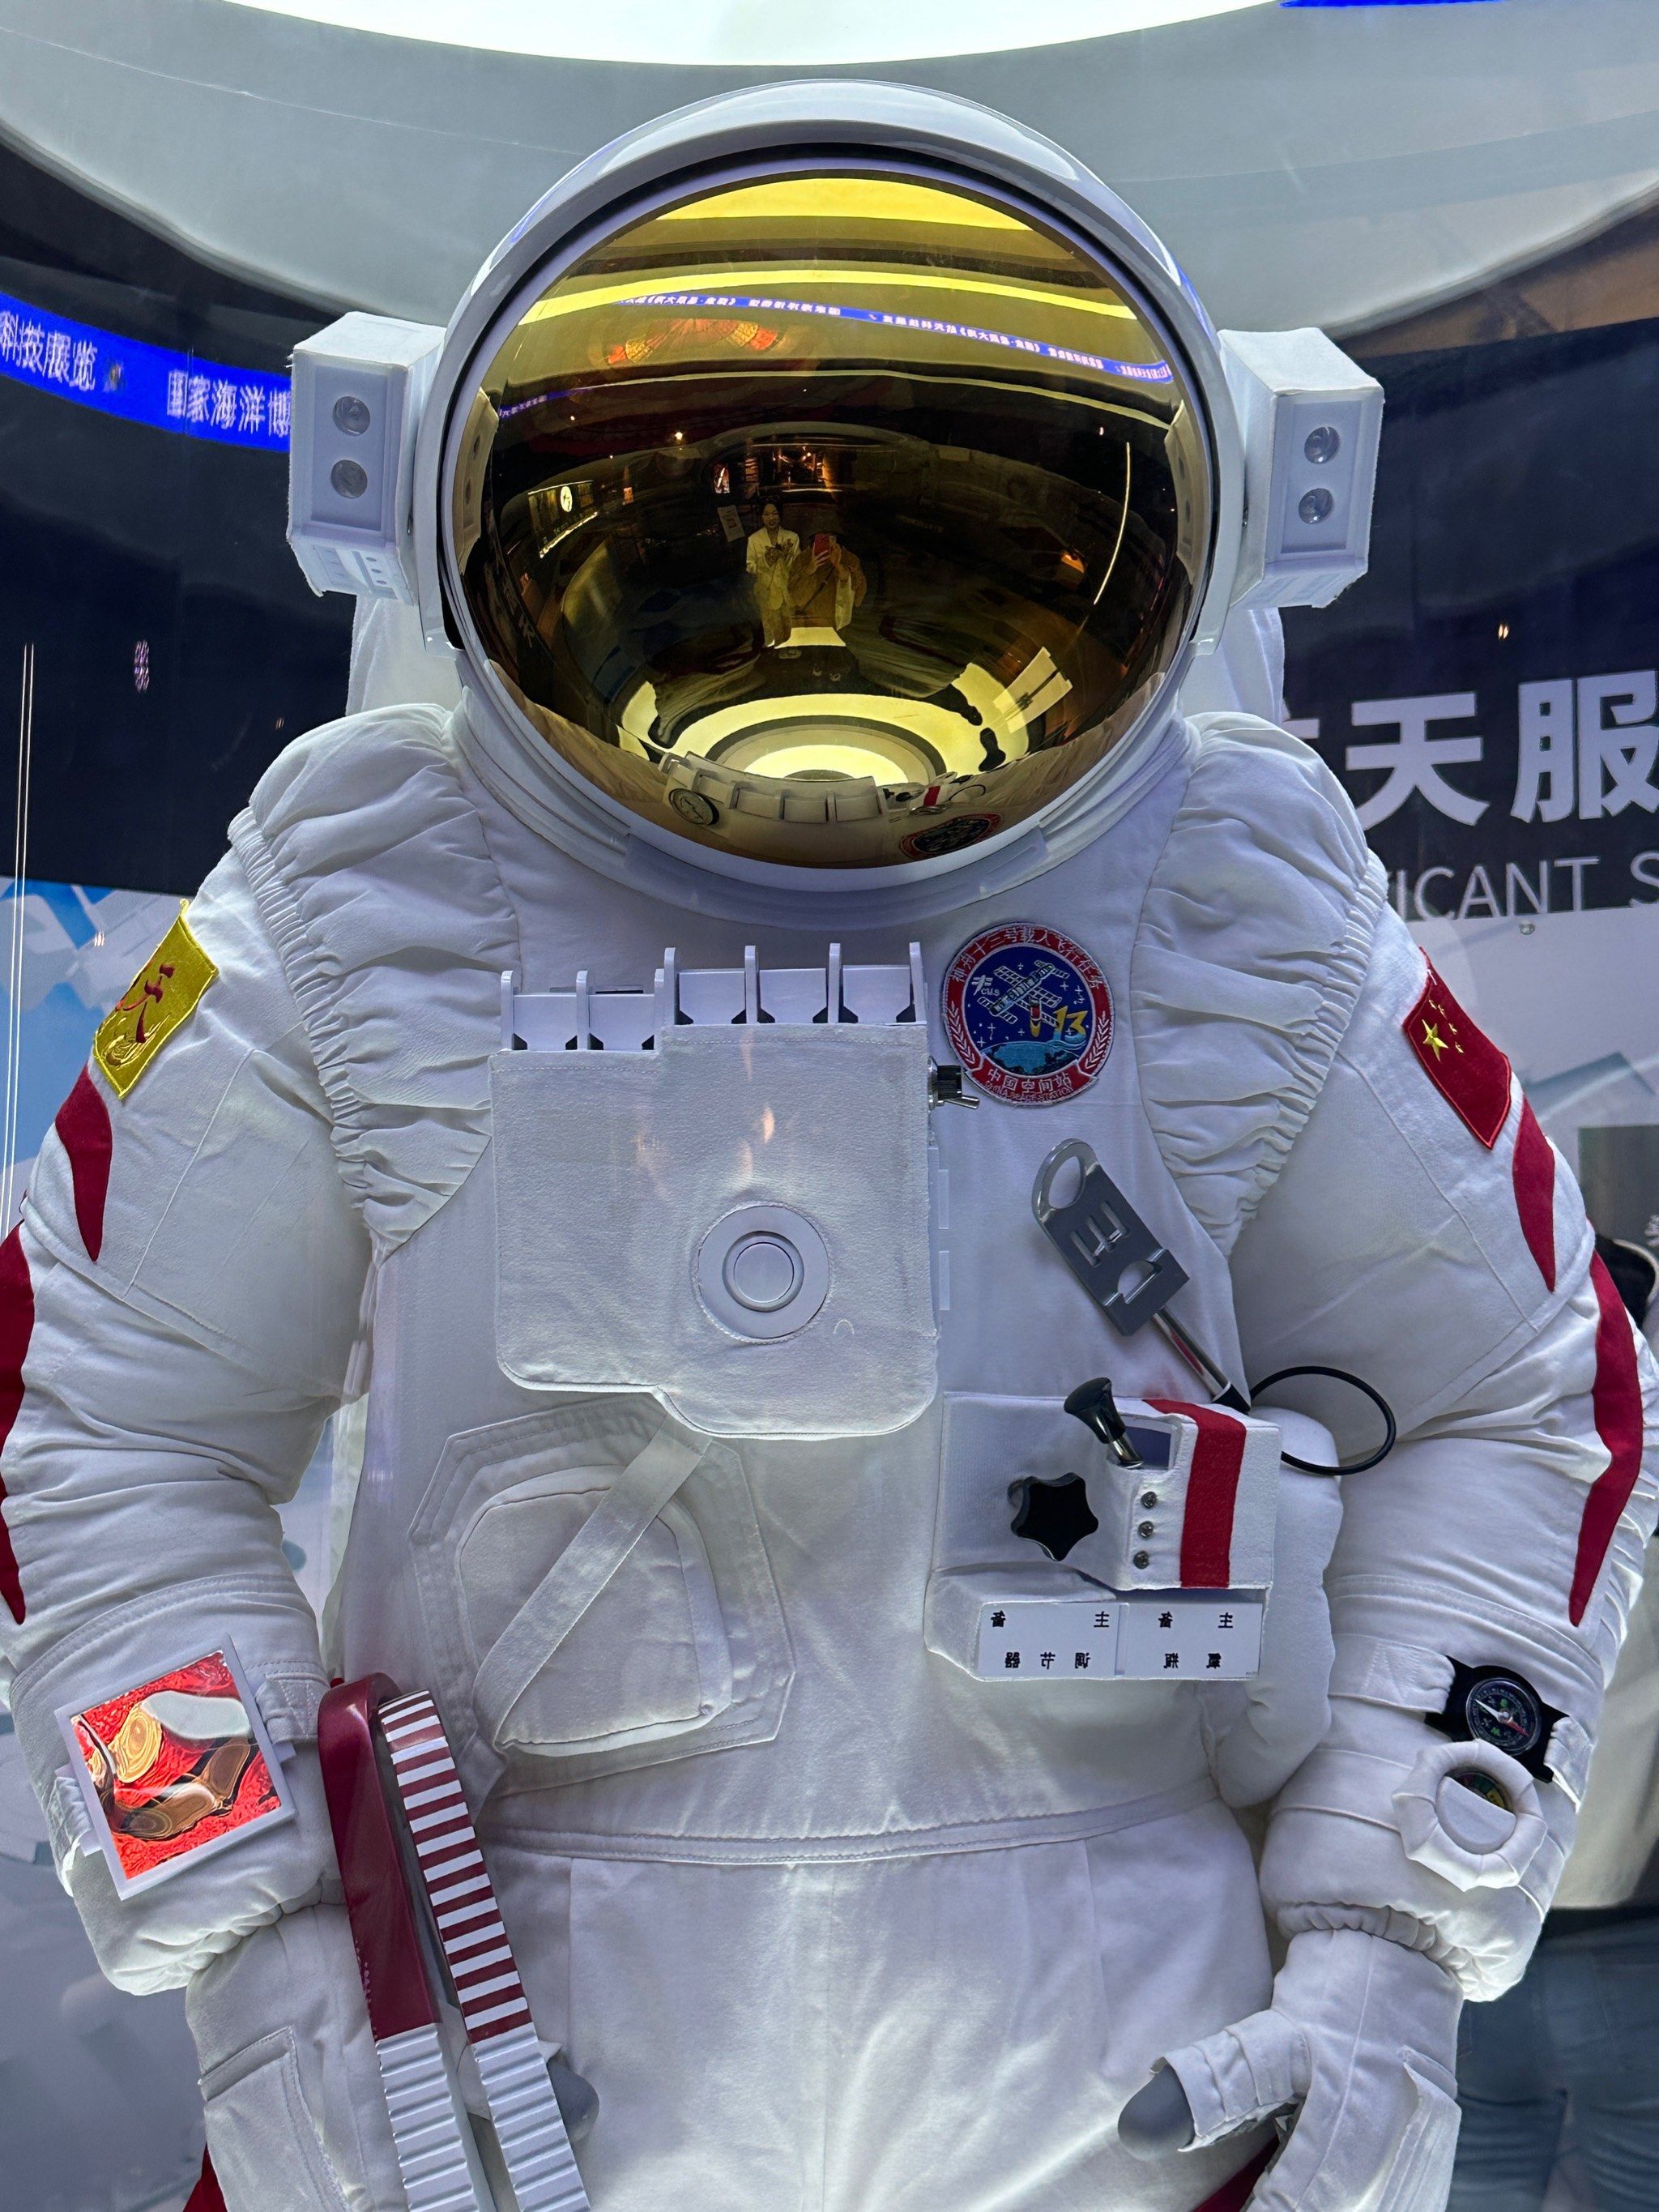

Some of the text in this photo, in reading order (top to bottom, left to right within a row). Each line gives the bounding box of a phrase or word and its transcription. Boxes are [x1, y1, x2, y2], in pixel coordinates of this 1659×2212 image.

[1285, 669, 1659, 831] 天服
[1387, 856, 1600, 920] ICANT
[1052, 1005, 1089, 1044] 13
[987, 1067, 1073, 1093] 中国空间站
